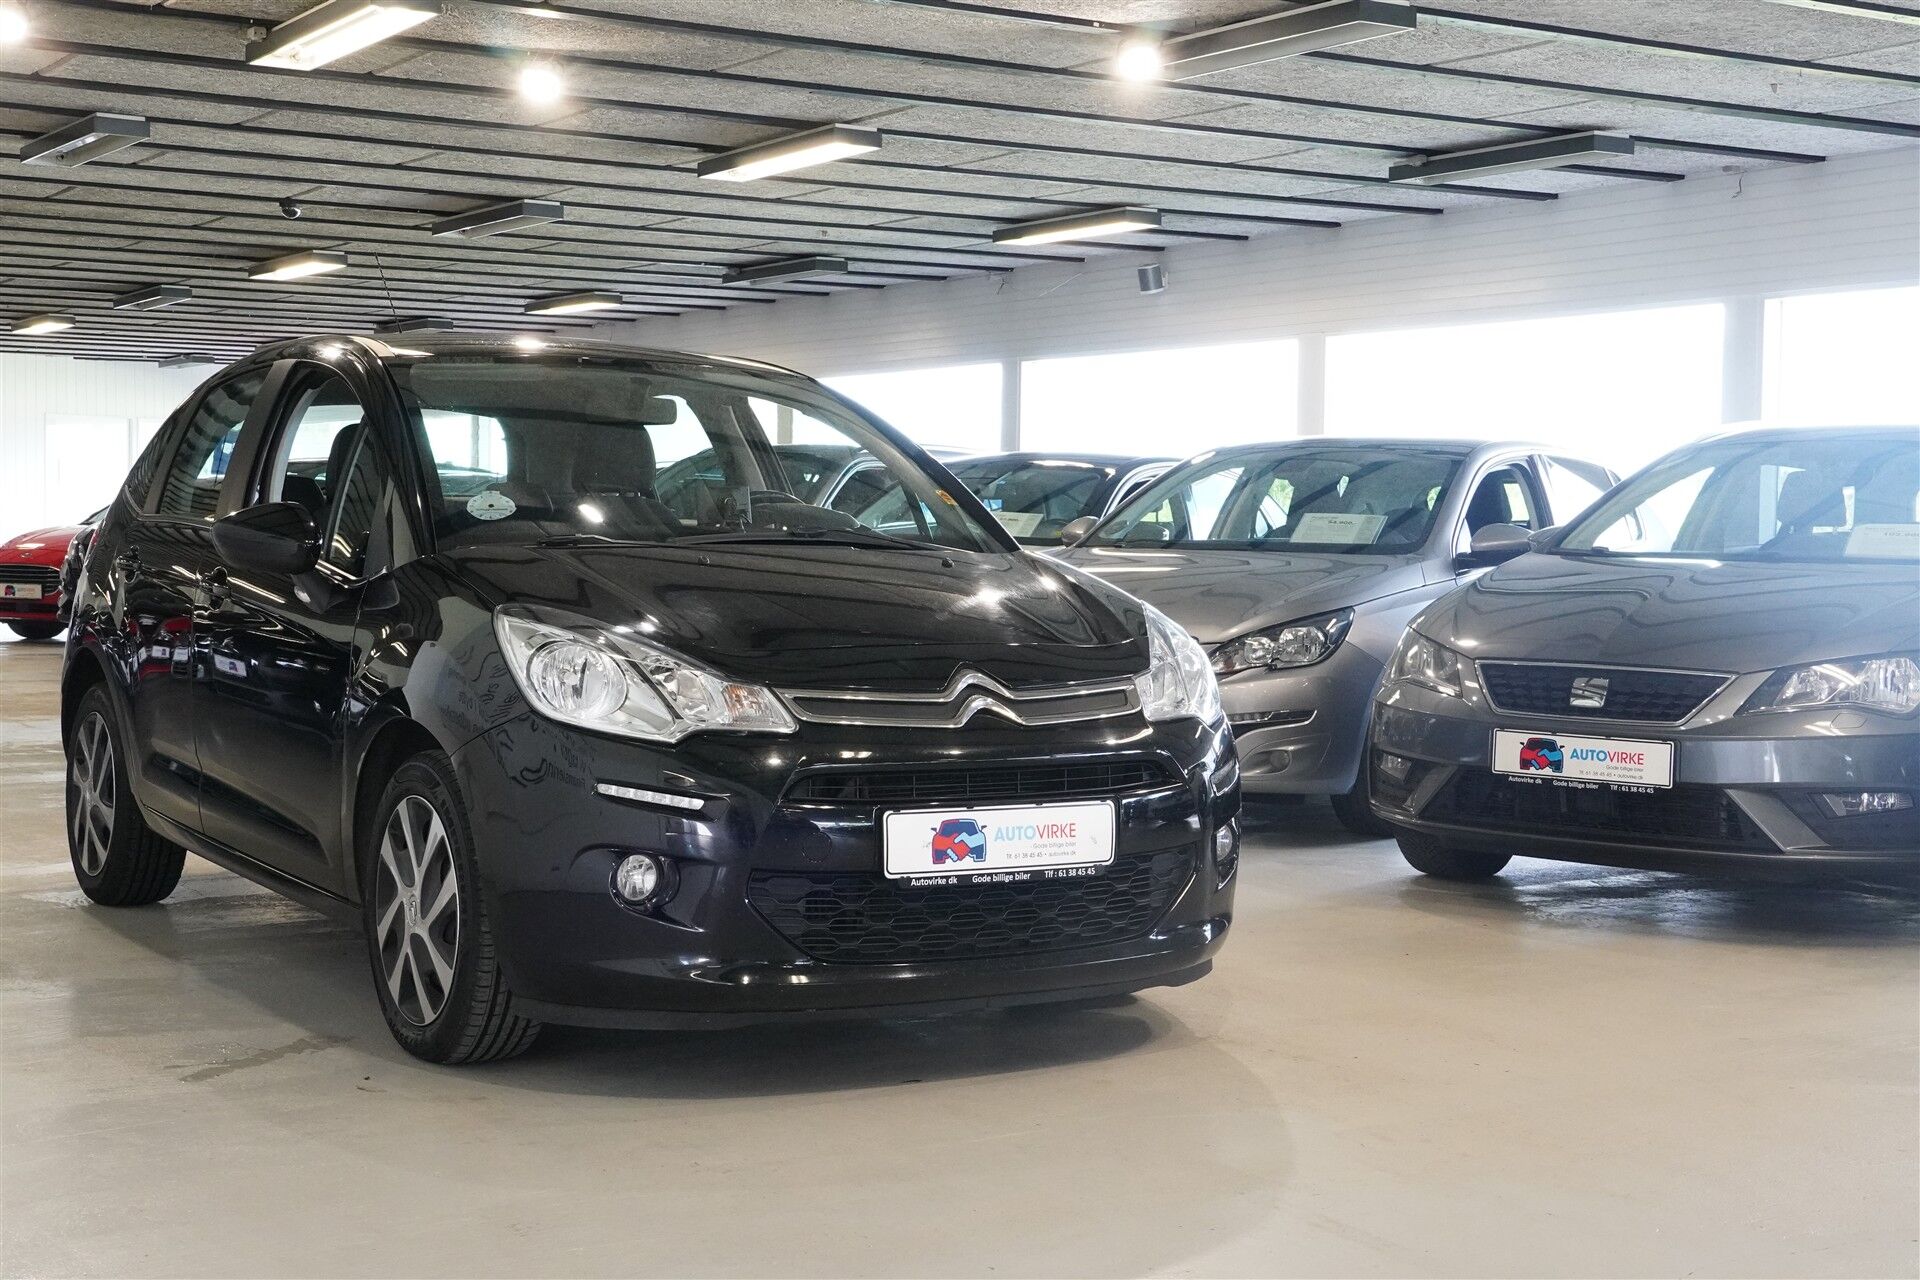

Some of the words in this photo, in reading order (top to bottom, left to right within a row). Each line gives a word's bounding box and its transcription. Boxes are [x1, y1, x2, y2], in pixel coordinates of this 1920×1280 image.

[1570, 747, 1644, 765] AUTOVIRKE
[1568, 781, 1585, 789] billige
[994, 822, 1076, 842] AUTOVIRKE
[972, 874, 992, 882] Gode
[992, 872, 1014, 882] billige
[1014, 872, 1031, 880] biler
[1058, 869, 1066, 877] 61
[1068, 868, 1076, 876] 38
[1087, 867, 1096, 875] 45
[910, 876, 946, 886] Autovirke
